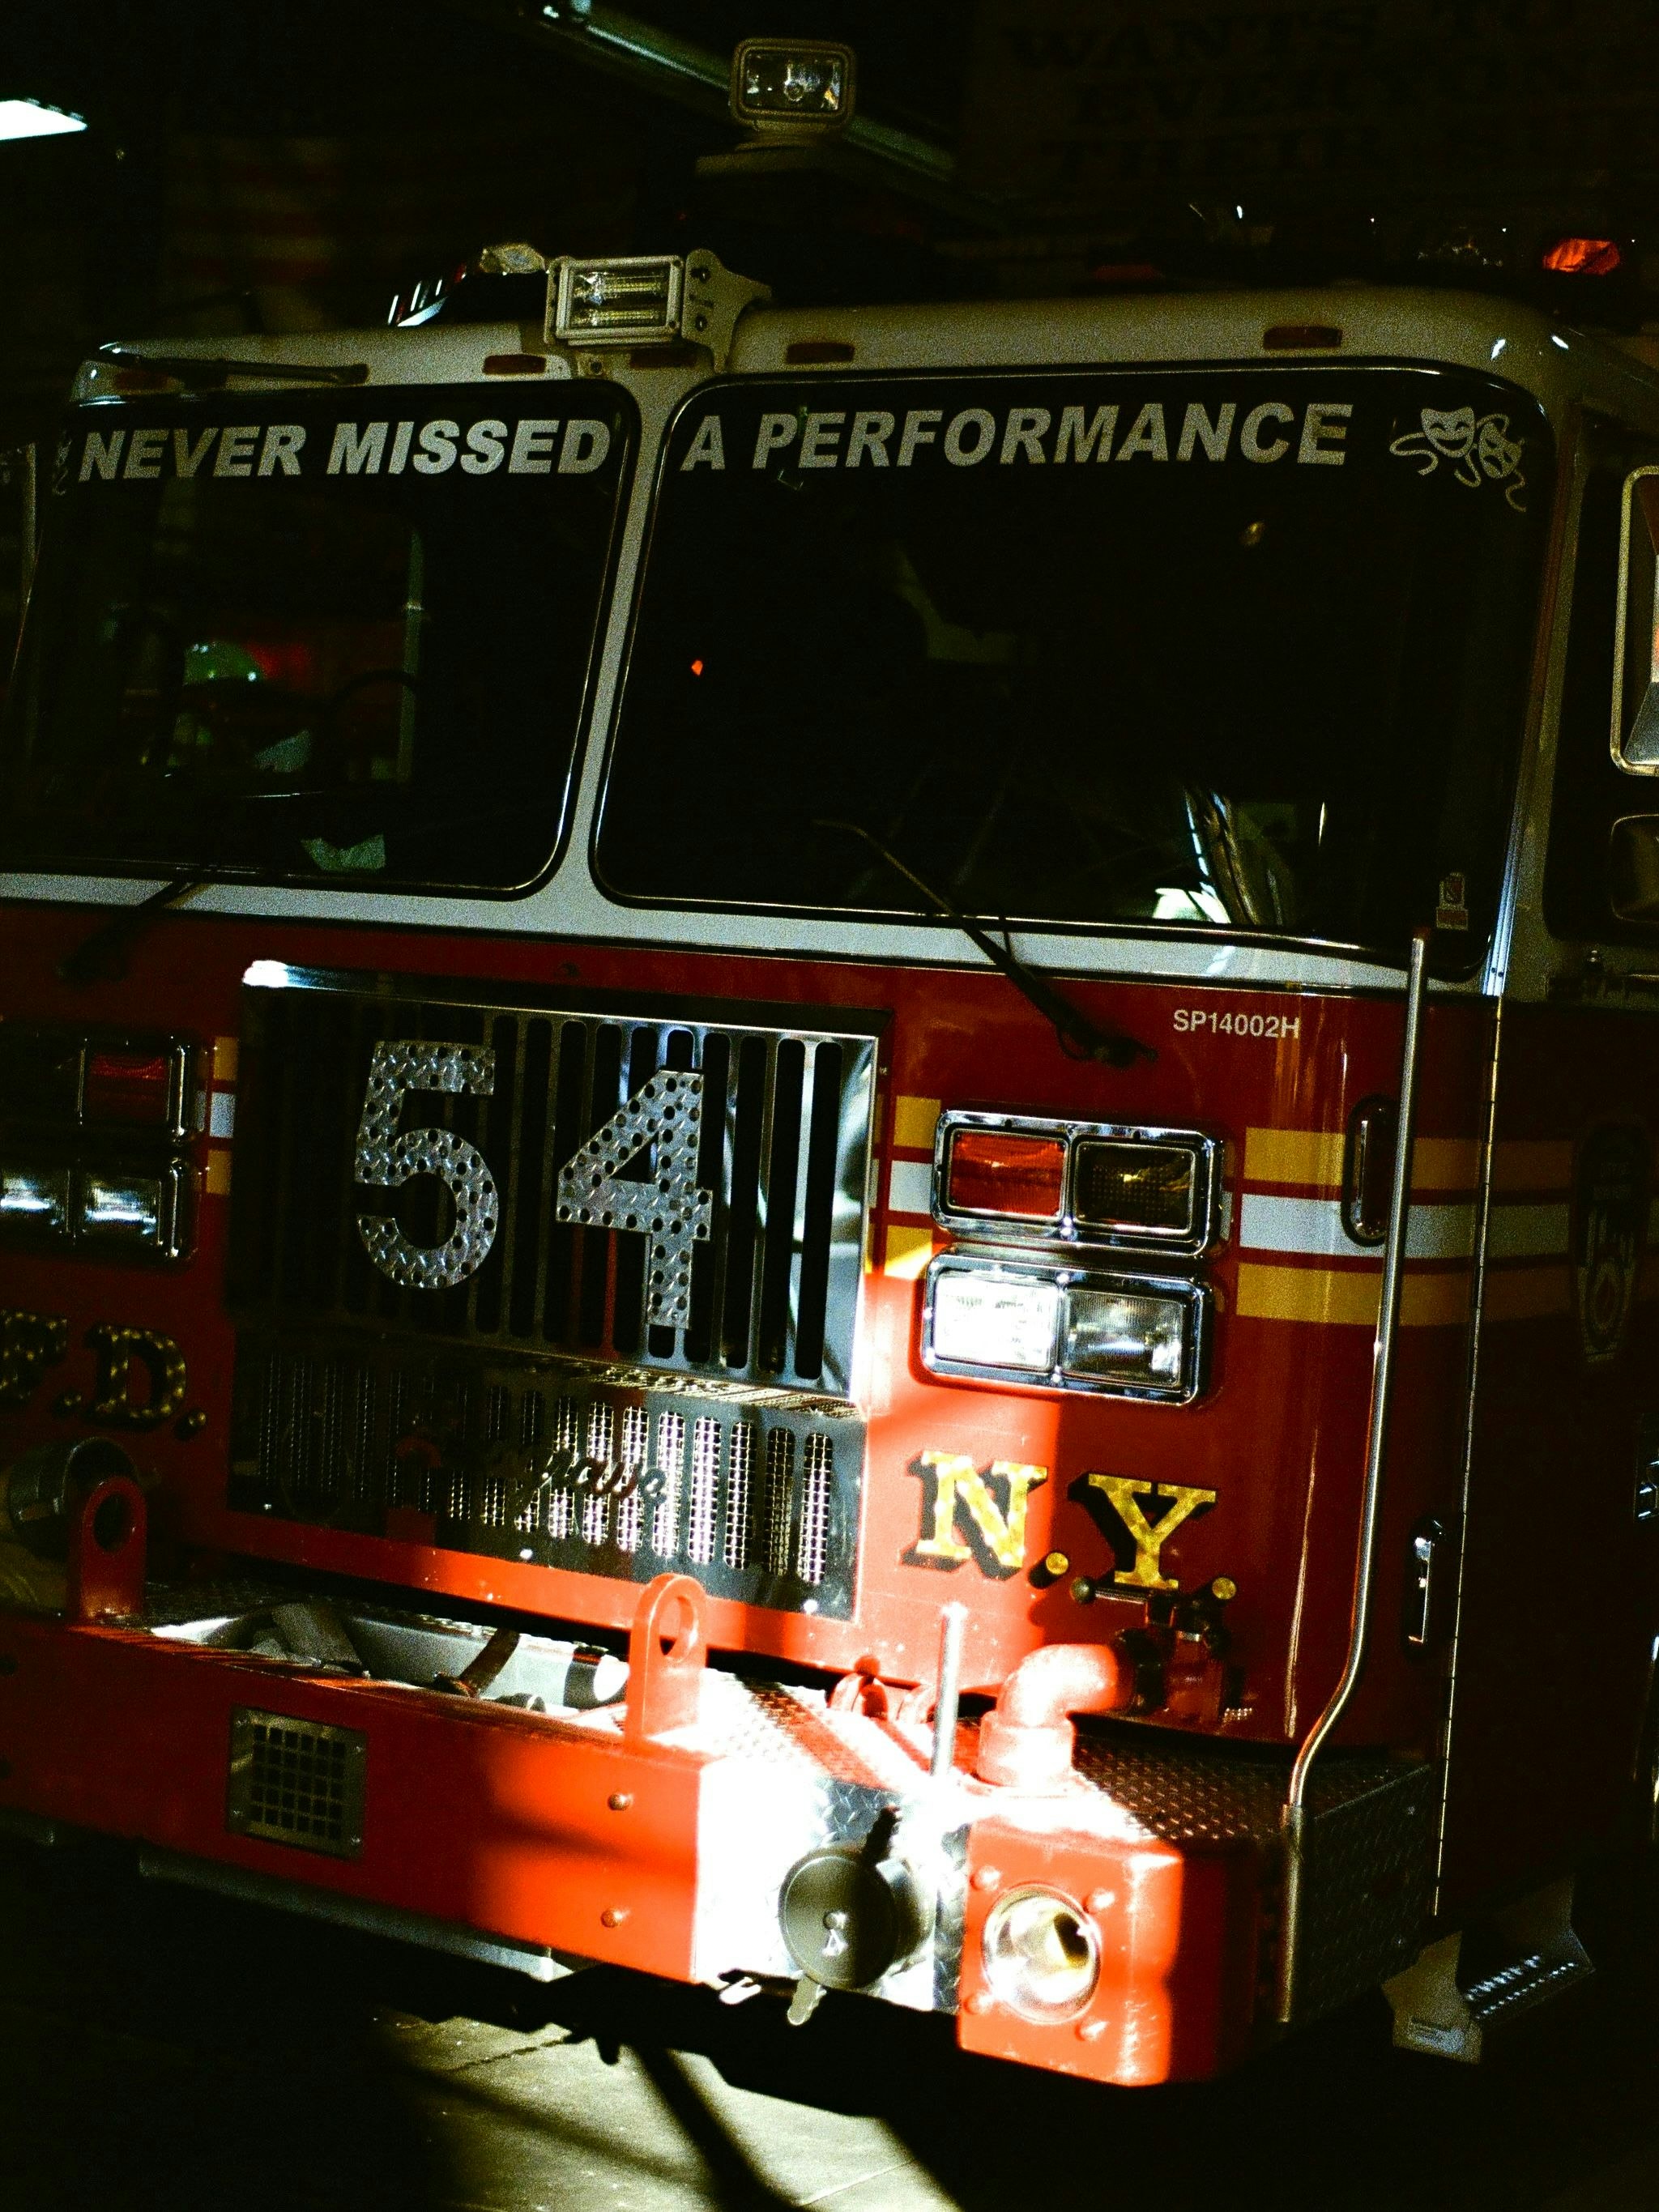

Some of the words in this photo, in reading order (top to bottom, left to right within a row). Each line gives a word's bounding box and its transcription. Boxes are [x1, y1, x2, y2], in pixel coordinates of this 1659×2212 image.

[80, 425, 307, 482] NEVER
[326, 419, 611, 475] MISSED
[679, 415, 727, 471] A
[751, 402, 1354, 469] PERFORMANCE
[1173, 1008, 1300, 1040] SP14002H
[354, 1040, 714, 1330] 54
[904, 1450, 1237, 1600] N.Y.
